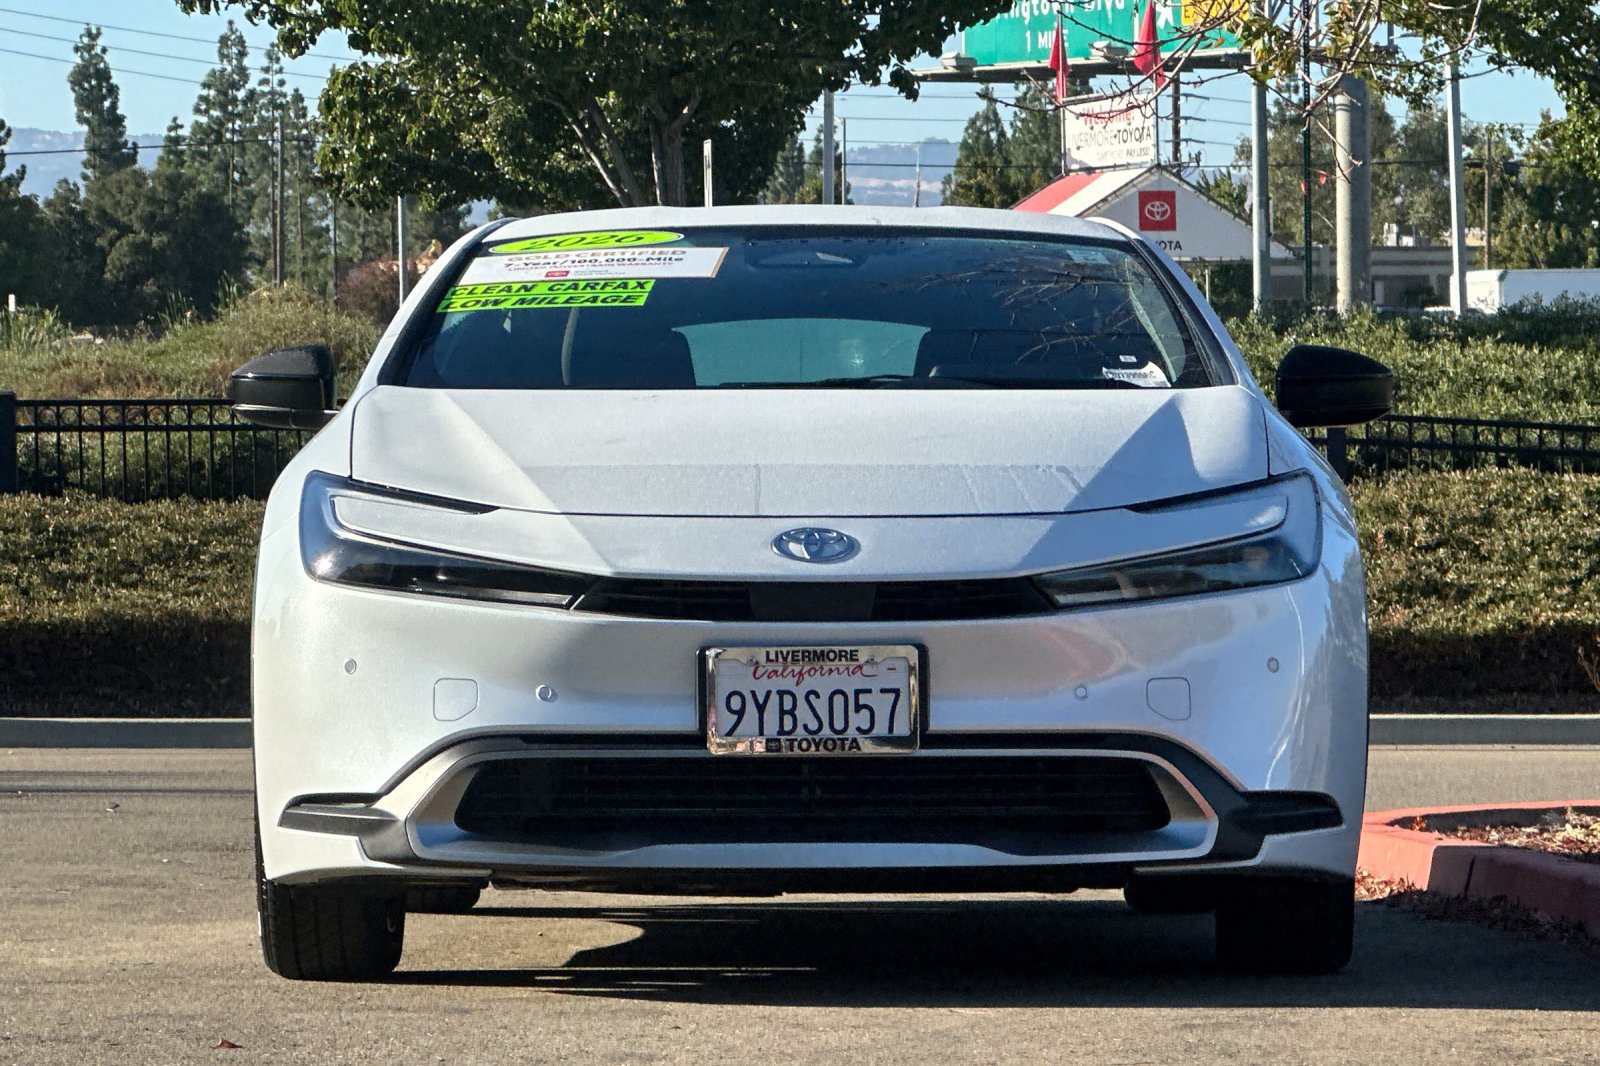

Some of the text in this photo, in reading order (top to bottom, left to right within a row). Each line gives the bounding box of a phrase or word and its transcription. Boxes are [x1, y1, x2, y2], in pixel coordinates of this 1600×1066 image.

[1025, 29, 1069, 52] 1 MIE
[1117, 125, 1152, 144] TOYOTA
[520, 232, 654, 251] 2026
[1155, 240, 1183, 251] OTA
[507, 249, 687, 262] GOLD CERTIFIED
[450, 280, 649, 296] CLEAN CARFAX
[443, 294, 640, 311] LOW MILEAGE
[765, 649, 859, 663] LIVERMORE
[752, 663, 878, 687] California
[725, 688, 901, 737] 9YBS057
[785, 737, 862, 752] TOYOTA
